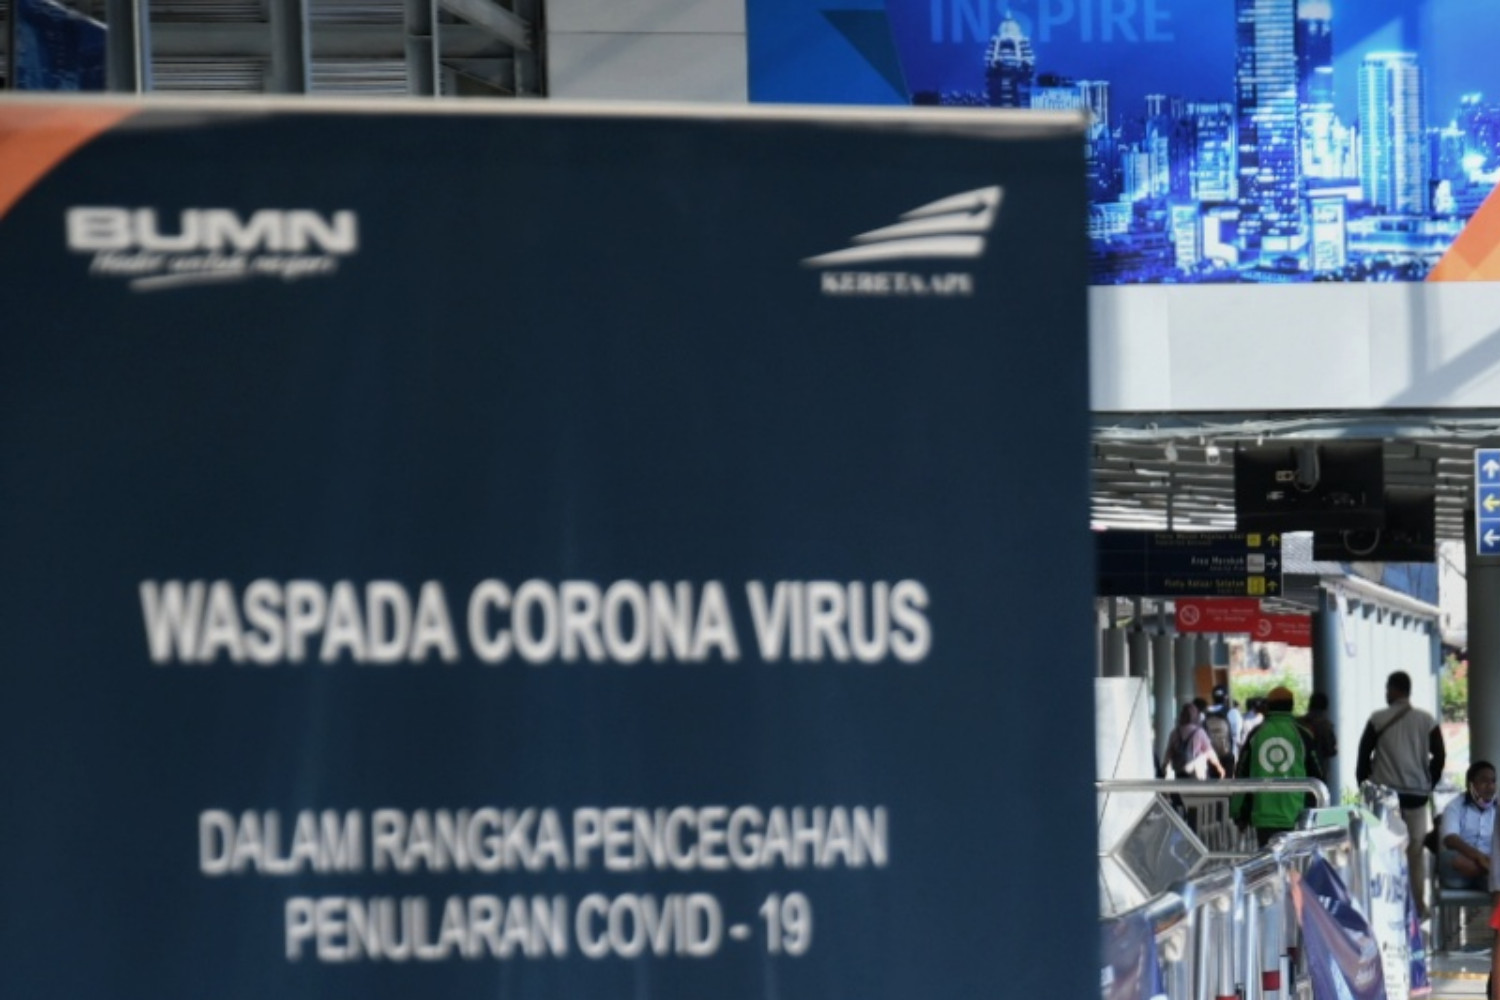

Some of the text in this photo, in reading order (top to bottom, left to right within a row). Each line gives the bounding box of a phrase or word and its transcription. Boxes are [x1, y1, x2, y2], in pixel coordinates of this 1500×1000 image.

[66, 206, 357, 252] BUMN
[140, 578, 931, 664] WASPADA CORONA VIRUS
[199, 804, 888, 874] DALAM RANGKA PENCEGAHAN
[284, 893, 568, 961] PENULARAN
[574, 891, 721, 958] COVID
[758, 891, 811, 955] 19
